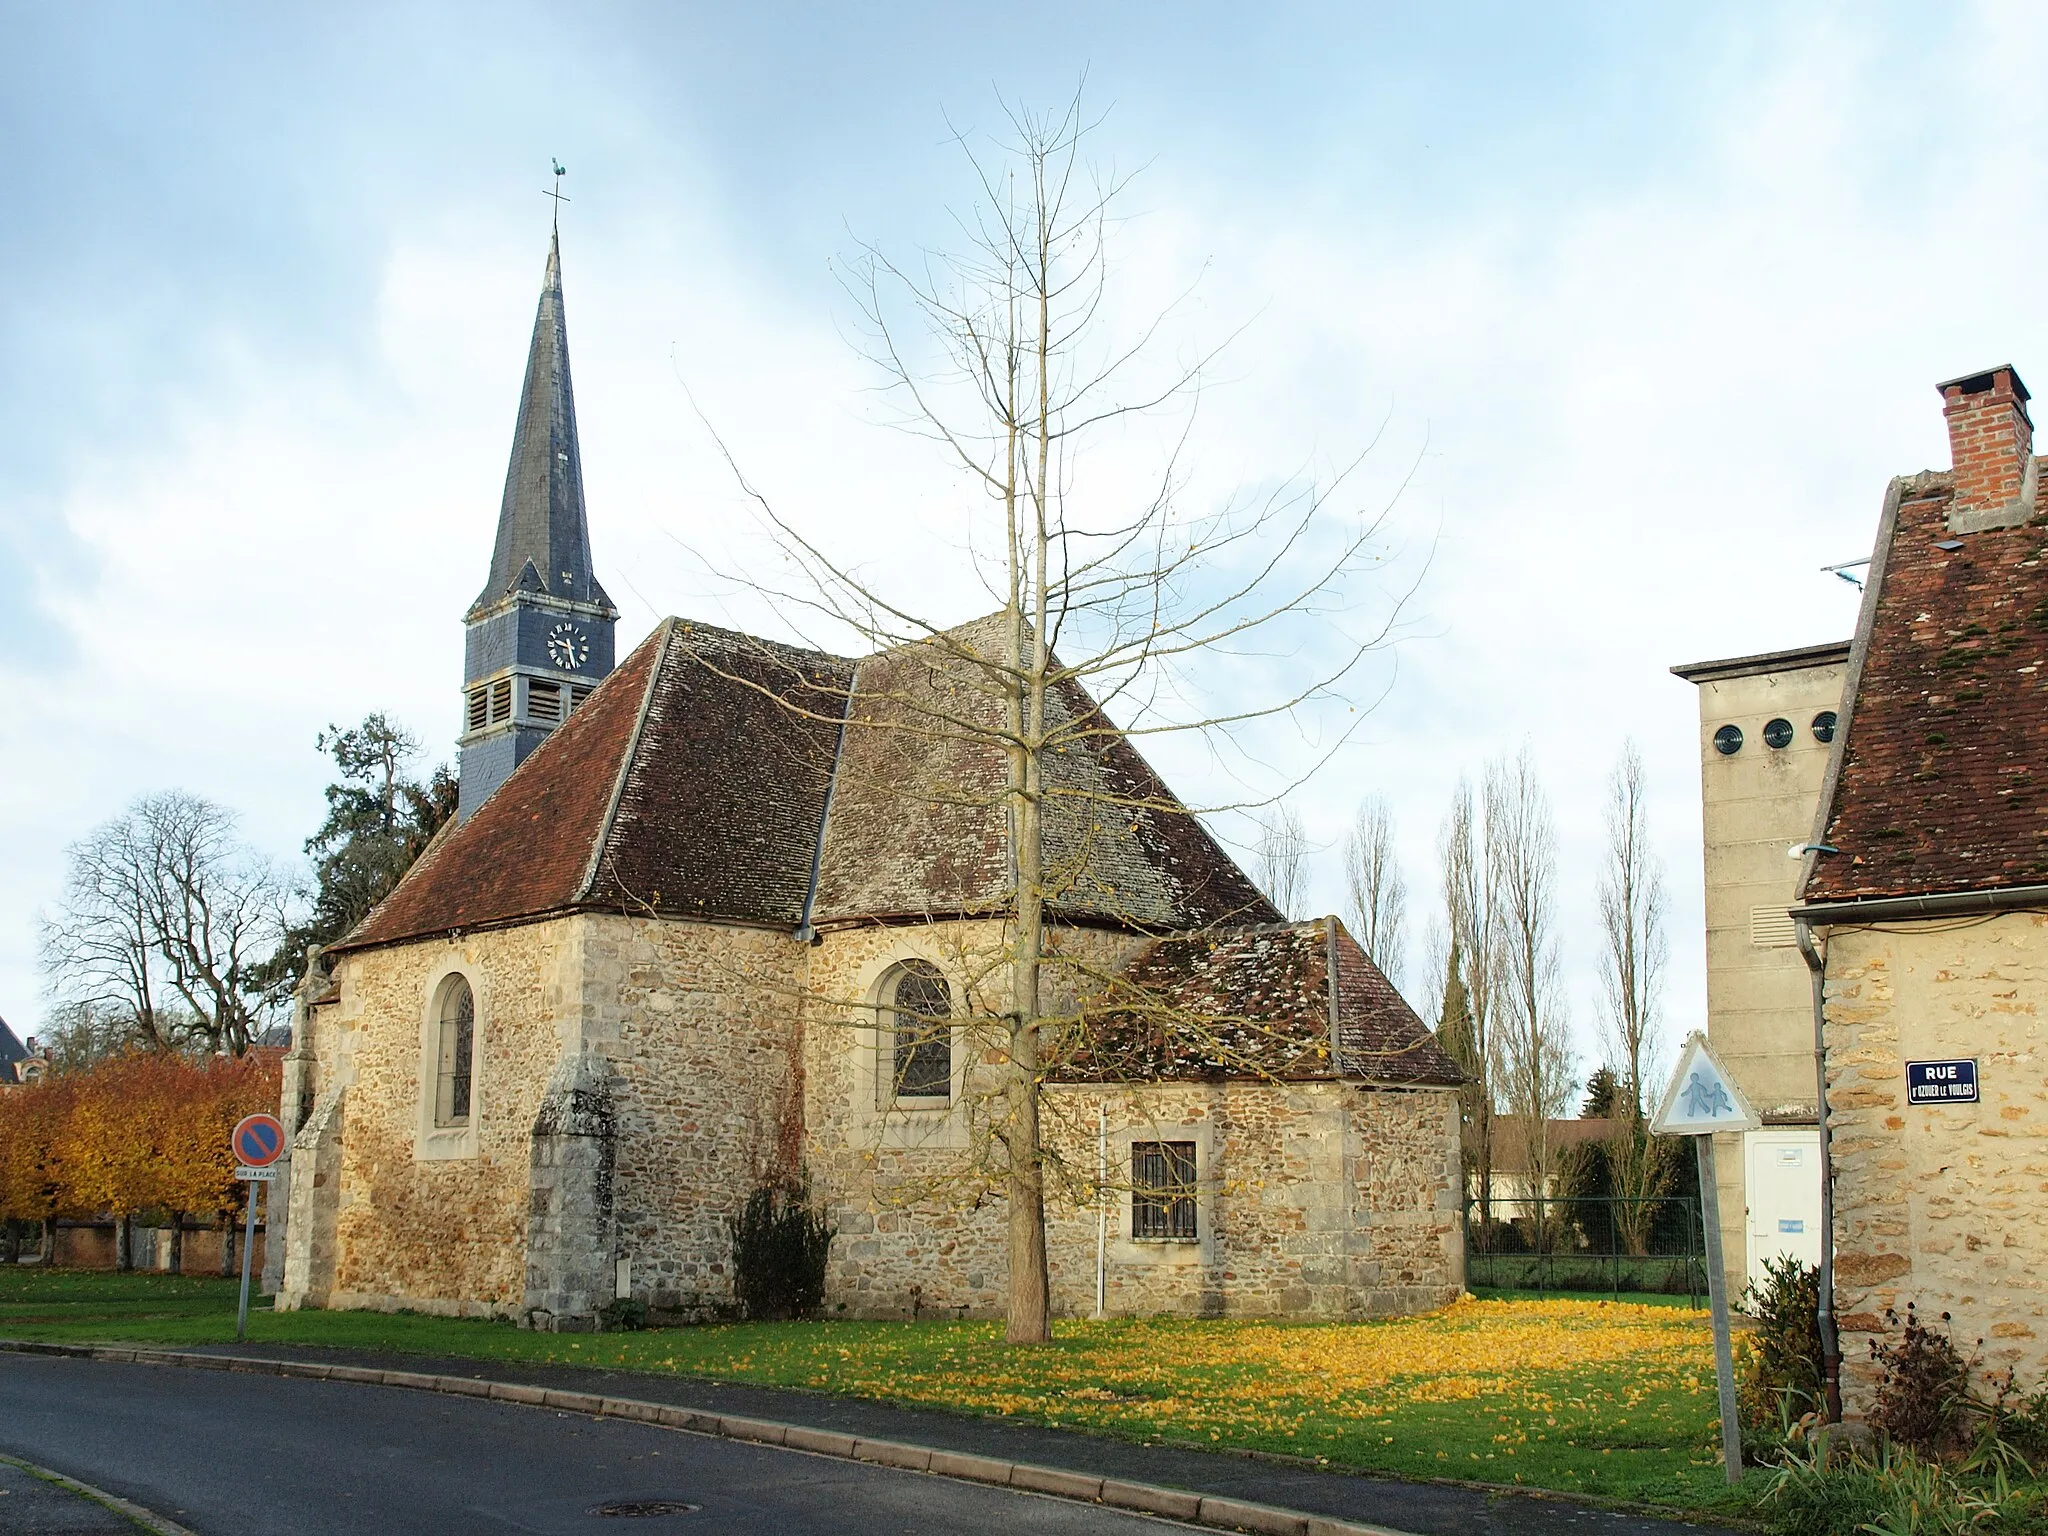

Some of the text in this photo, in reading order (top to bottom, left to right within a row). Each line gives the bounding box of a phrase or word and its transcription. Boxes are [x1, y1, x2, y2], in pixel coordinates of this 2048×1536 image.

[1925, 1066, 1957, 1080] RUE
[1940, 1086, 1947, 1096] LE
[1948, 1084, 1973, 1096] VOULGIS
